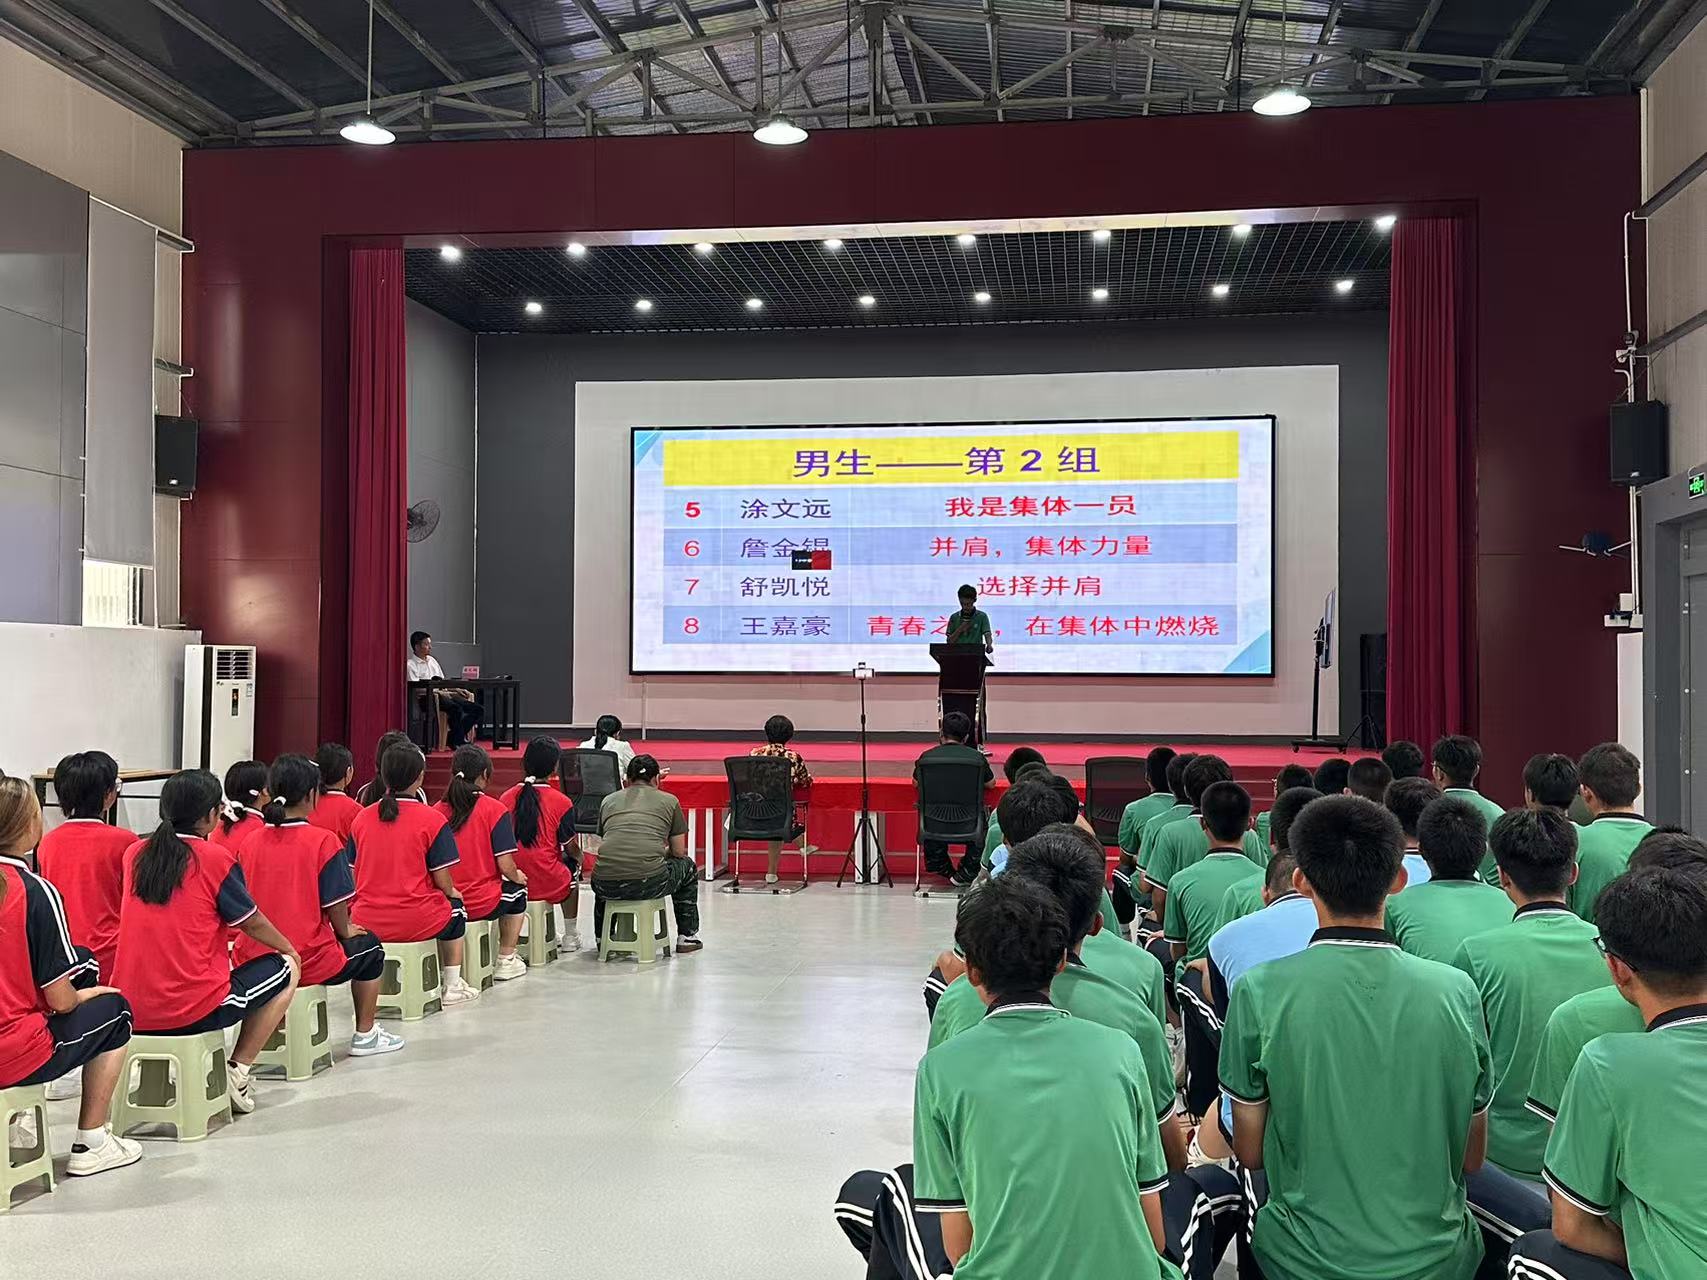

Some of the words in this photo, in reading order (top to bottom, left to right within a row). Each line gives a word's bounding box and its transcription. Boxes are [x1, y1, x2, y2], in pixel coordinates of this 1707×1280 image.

[685, 501, 701, 518] 5
[740, 498, 831, 519] 涂文远
[945, 495, 1137, 517] 我是集体一员
[684, 540, 700, 557] 6
[929, 535, 1152, 557] 并肩，集体力量
[685, 579, 700, 595] 7
[740, 576, 831, 598] 舒凯悦
[976, 576, 1101, 596] 选择并肩
[684, 617, 700, 634] 8
[740, 616, 831, 636] 王嘉豪
[867, 615, 1220, 637] 青春之，在集体中燃烧
